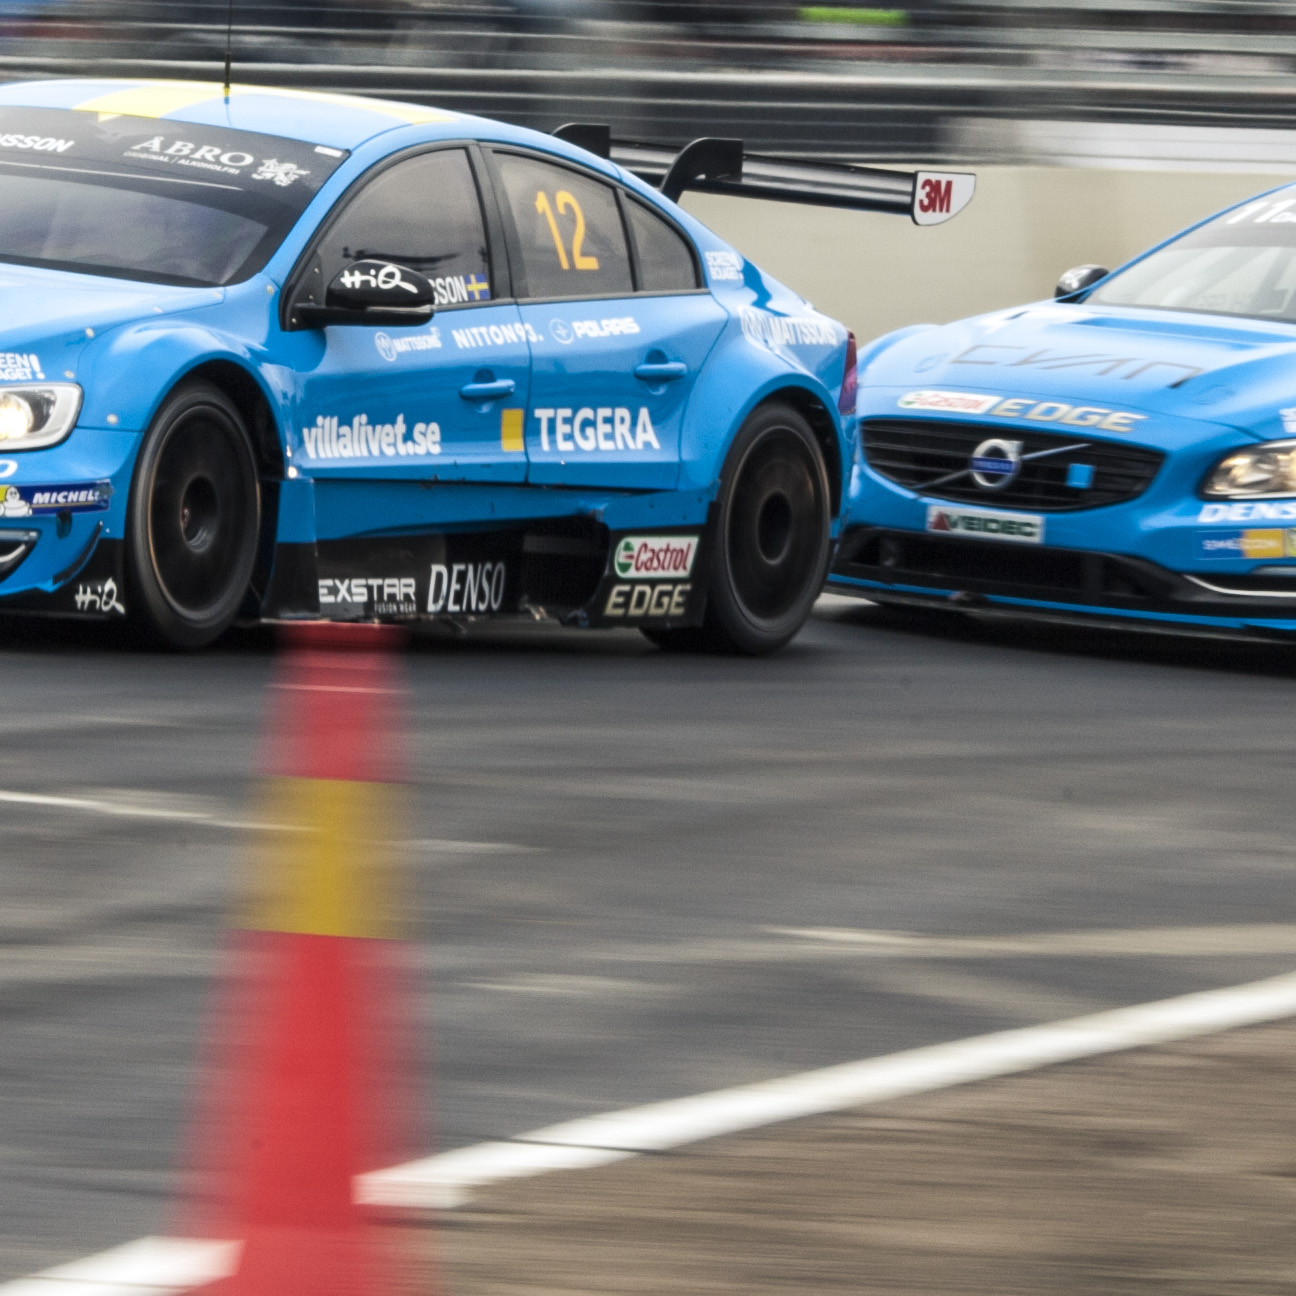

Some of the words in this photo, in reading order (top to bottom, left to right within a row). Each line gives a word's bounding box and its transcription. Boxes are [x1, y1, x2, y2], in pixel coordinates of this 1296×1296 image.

[918, 179, 953, 214] 3M
[535, 190, 600, 271] 12
[572, 316, 641, 339] POLARIS
[534, 407, 661, 452] TEGERA
[990, 397, 1150, 433] EDGE
[303, 413, 441, 459] villalivet.se
[633, 541, 690, 574] Castrol
[318, 578, 416, 604] EXSTAR
[427, 561, 505, 613] DENSO
[603, 584, 692, 618] EDGE
